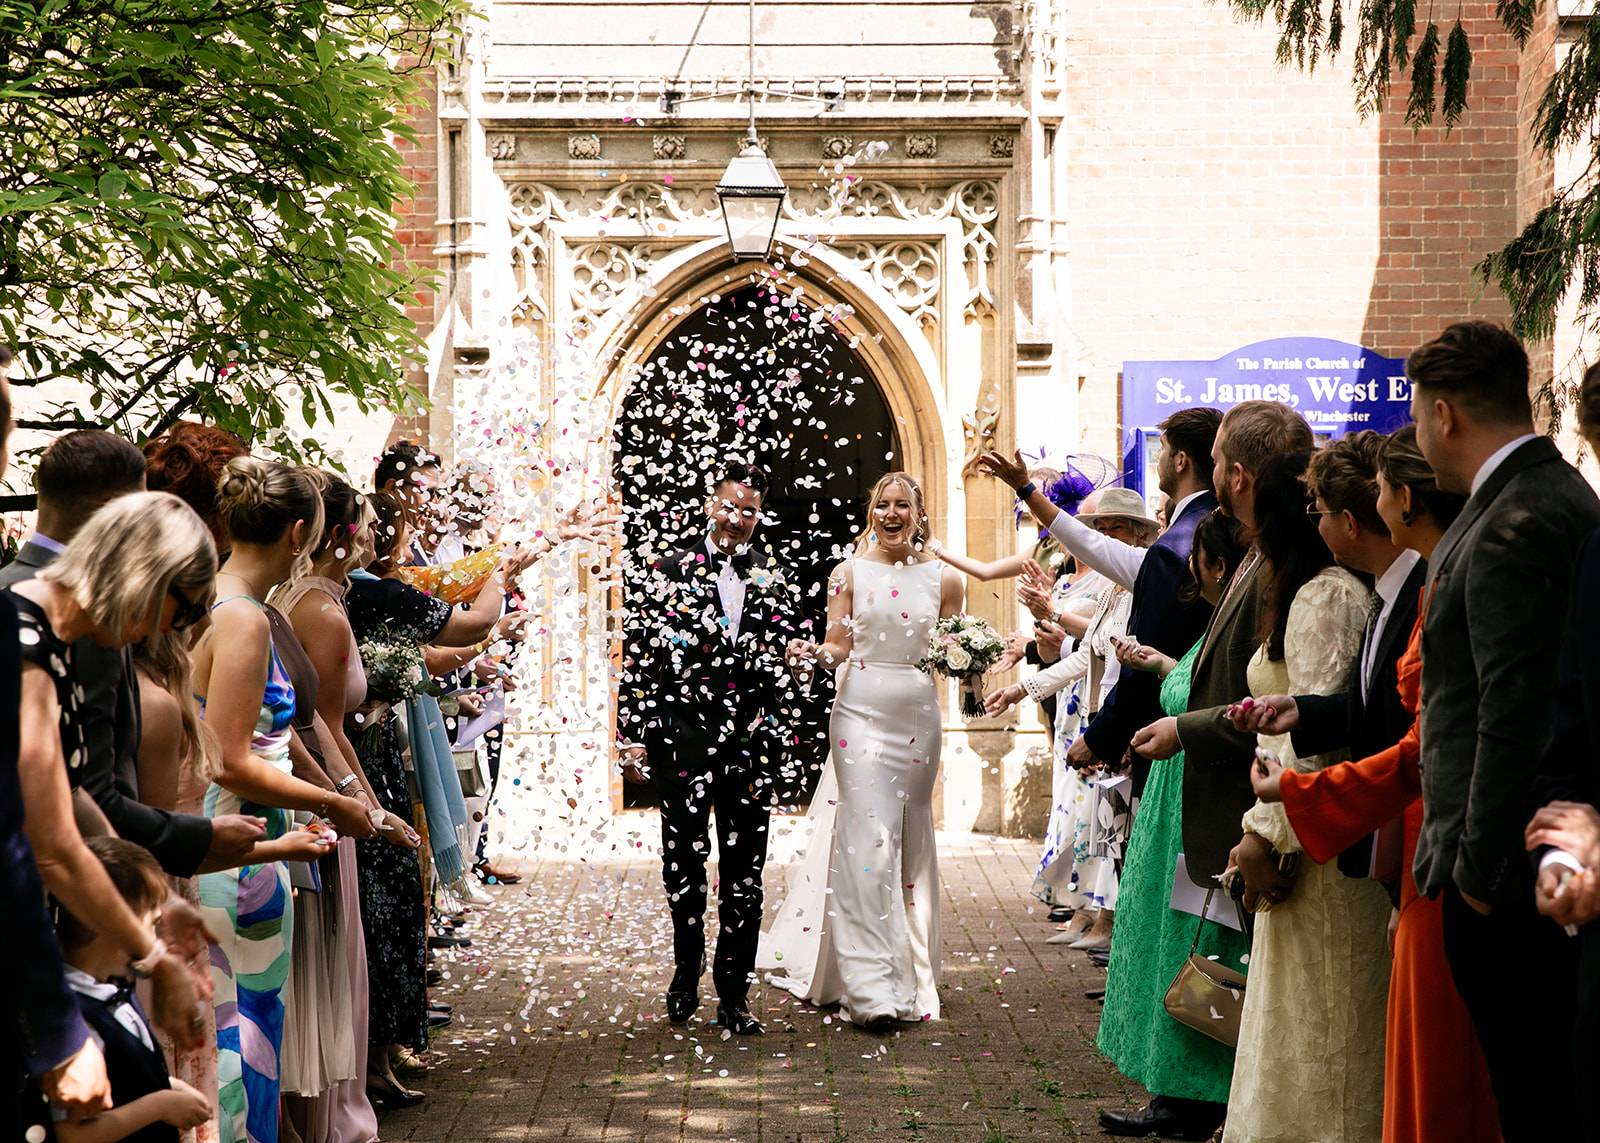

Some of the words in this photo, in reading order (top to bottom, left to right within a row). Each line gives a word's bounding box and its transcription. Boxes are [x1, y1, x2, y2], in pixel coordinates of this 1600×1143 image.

[1237, 358, 1259, 370] The
[1263, 357, 1302, 370] Parish
[1305, 357, 1349, 369] Church
[1352, 357, 1366, 369] of
[1156, 377, 1192, 403] St.
[1200, 377, 1299, 408] James,
[1306, 376, 1379, 402] West
[1304, 410, 1370, 422] Winchester
